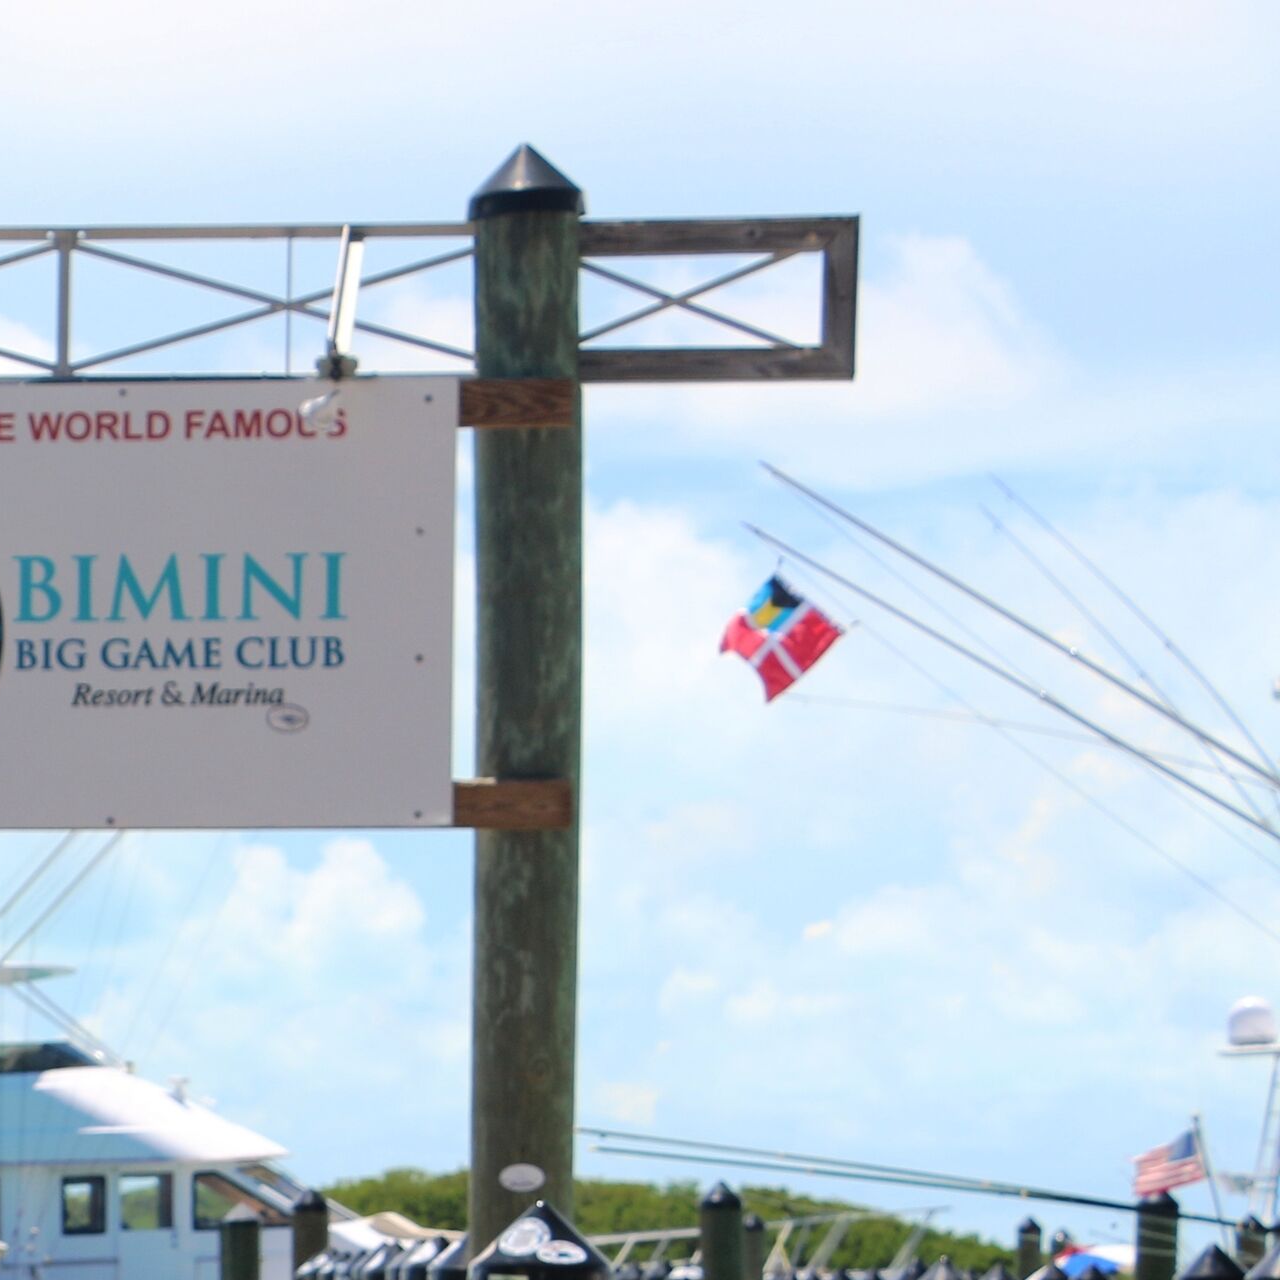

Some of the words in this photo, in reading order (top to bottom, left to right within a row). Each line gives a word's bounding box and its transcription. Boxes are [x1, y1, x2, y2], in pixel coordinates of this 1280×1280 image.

[29, 411, 170, 440] WORLD
[14, 553, 345, 622] BIMINI
[16, 638, 86, 671] BIG
[101, 638, 221, 670] GAME
[235, 636, 344, 669] CLUB
[72, 683, 153, 706] Resort
[161, 681, 184, 705] &
[196, 684, 283, 705] Marina
